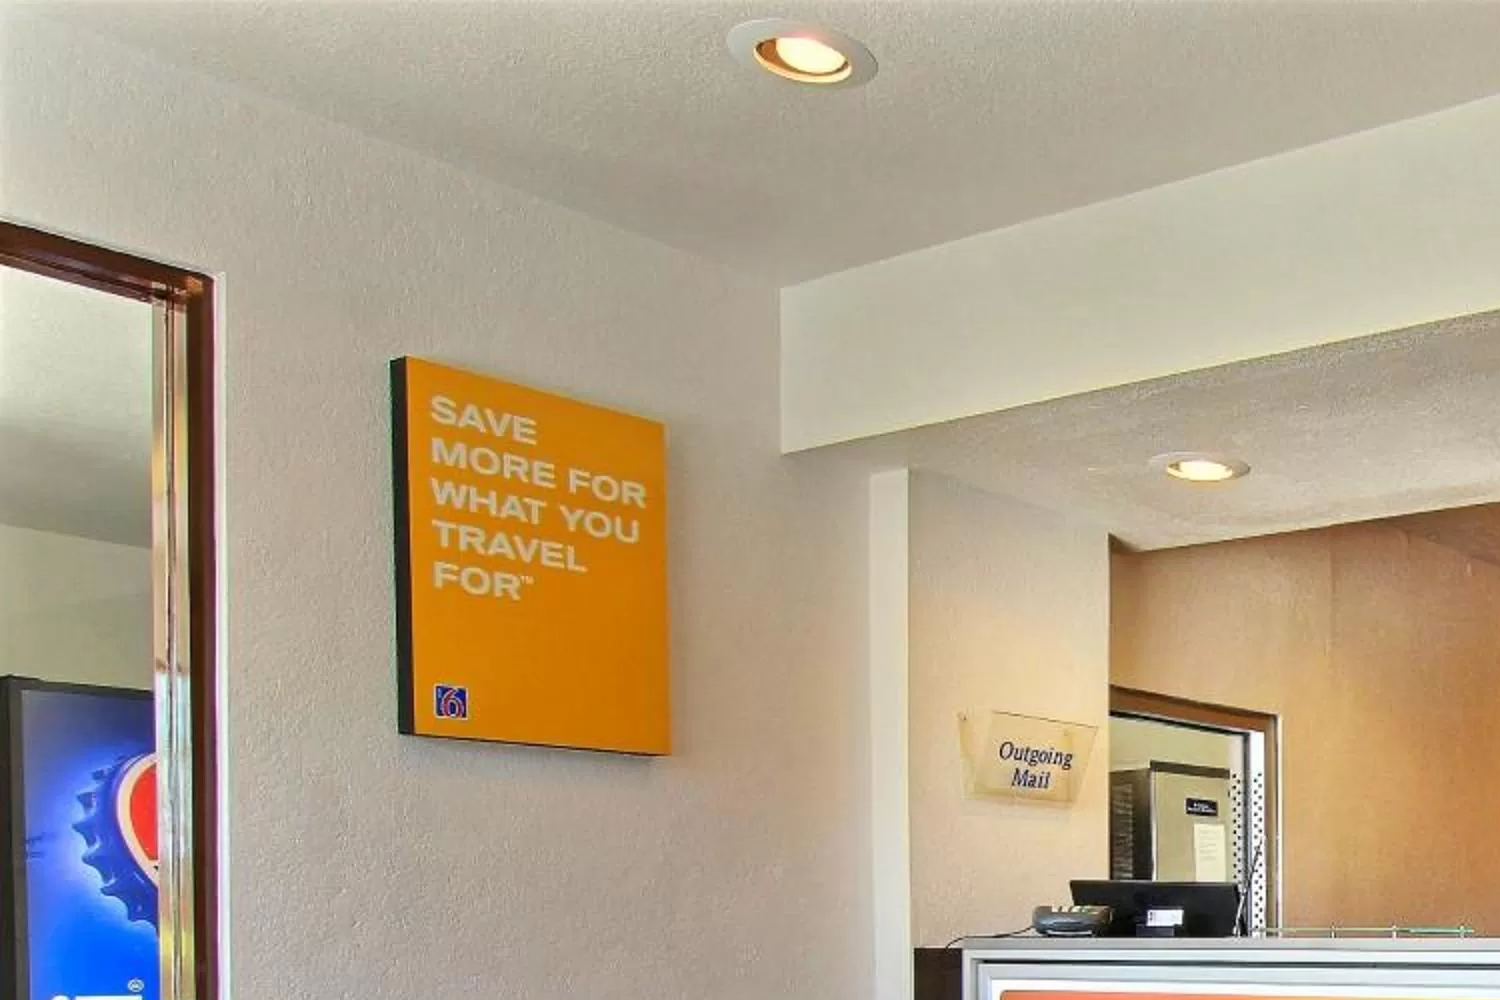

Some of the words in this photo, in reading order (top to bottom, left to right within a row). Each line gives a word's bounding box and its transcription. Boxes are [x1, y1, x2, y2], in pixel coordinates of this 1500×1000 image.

[431, 395, 538, 446] SAVE
[431, 437, 556, 489] MORE
[569, 467, 647, 509] FOR
[431, 478, 547, 525] WHAT
[559, 505, 640, 544] YOU
[432, 519, 589, 573] TRAVEL
[440, 687, 465, 719] 6
[999, 741, 1073, 770] Outgoing
[1011, 768, 1050, 789] Mail
